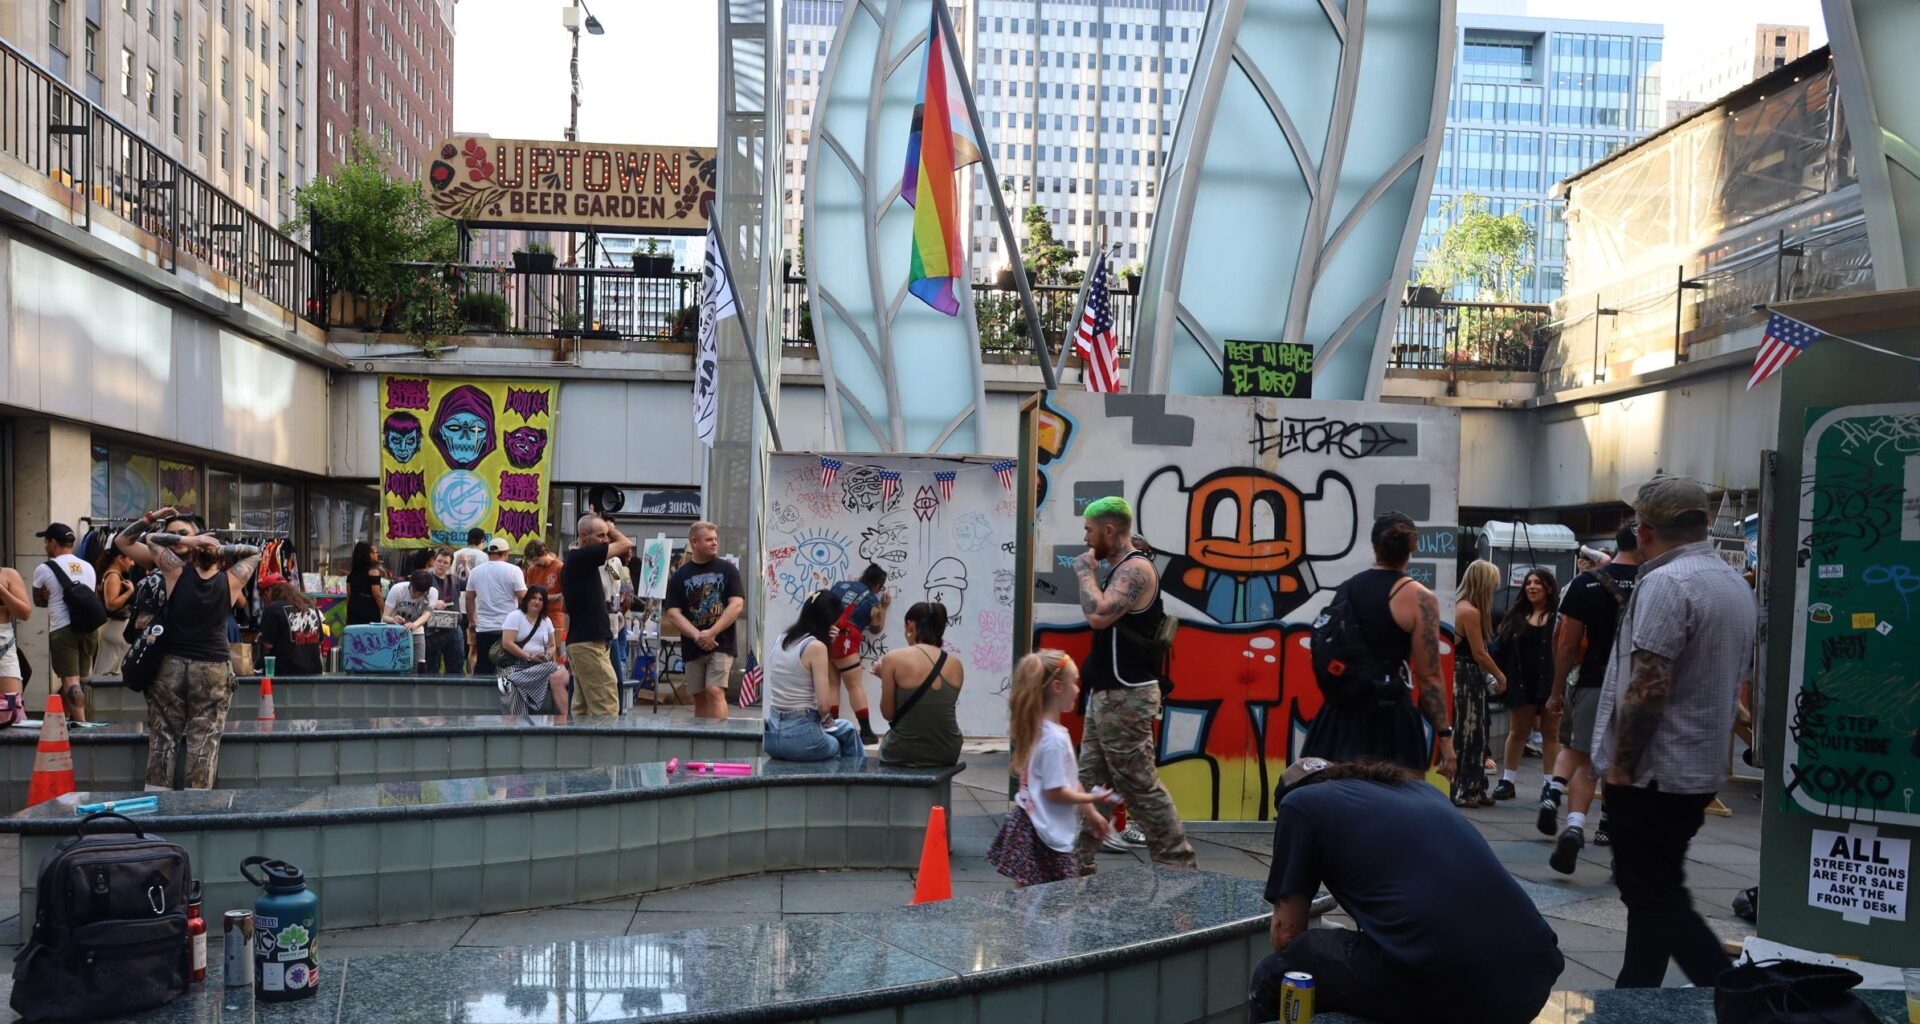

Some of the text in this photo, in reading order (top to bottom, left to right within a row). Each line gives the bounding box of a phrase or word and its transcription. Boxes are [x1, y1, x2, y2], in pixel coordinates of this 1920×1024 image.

[497, 145, 681, 194] UPTOWN
[509, 190, 666, 219] BEER GARDEN
[1836, 715, 1879, 733] STEP
[1819, 735, 1890, 755] OUTSIDE
[1785, 763, 1896, 799] XOXO
[1829, 835, 1889, 865] ALL
[1813, 857, 1906, 879] STREET SIGNS
[1813, 869, 1904, 891] ARE FOR SALE
[1829, 883, 1885, 900] ASK THE
[1817, 893, 1897, 914] FRONT DESK
